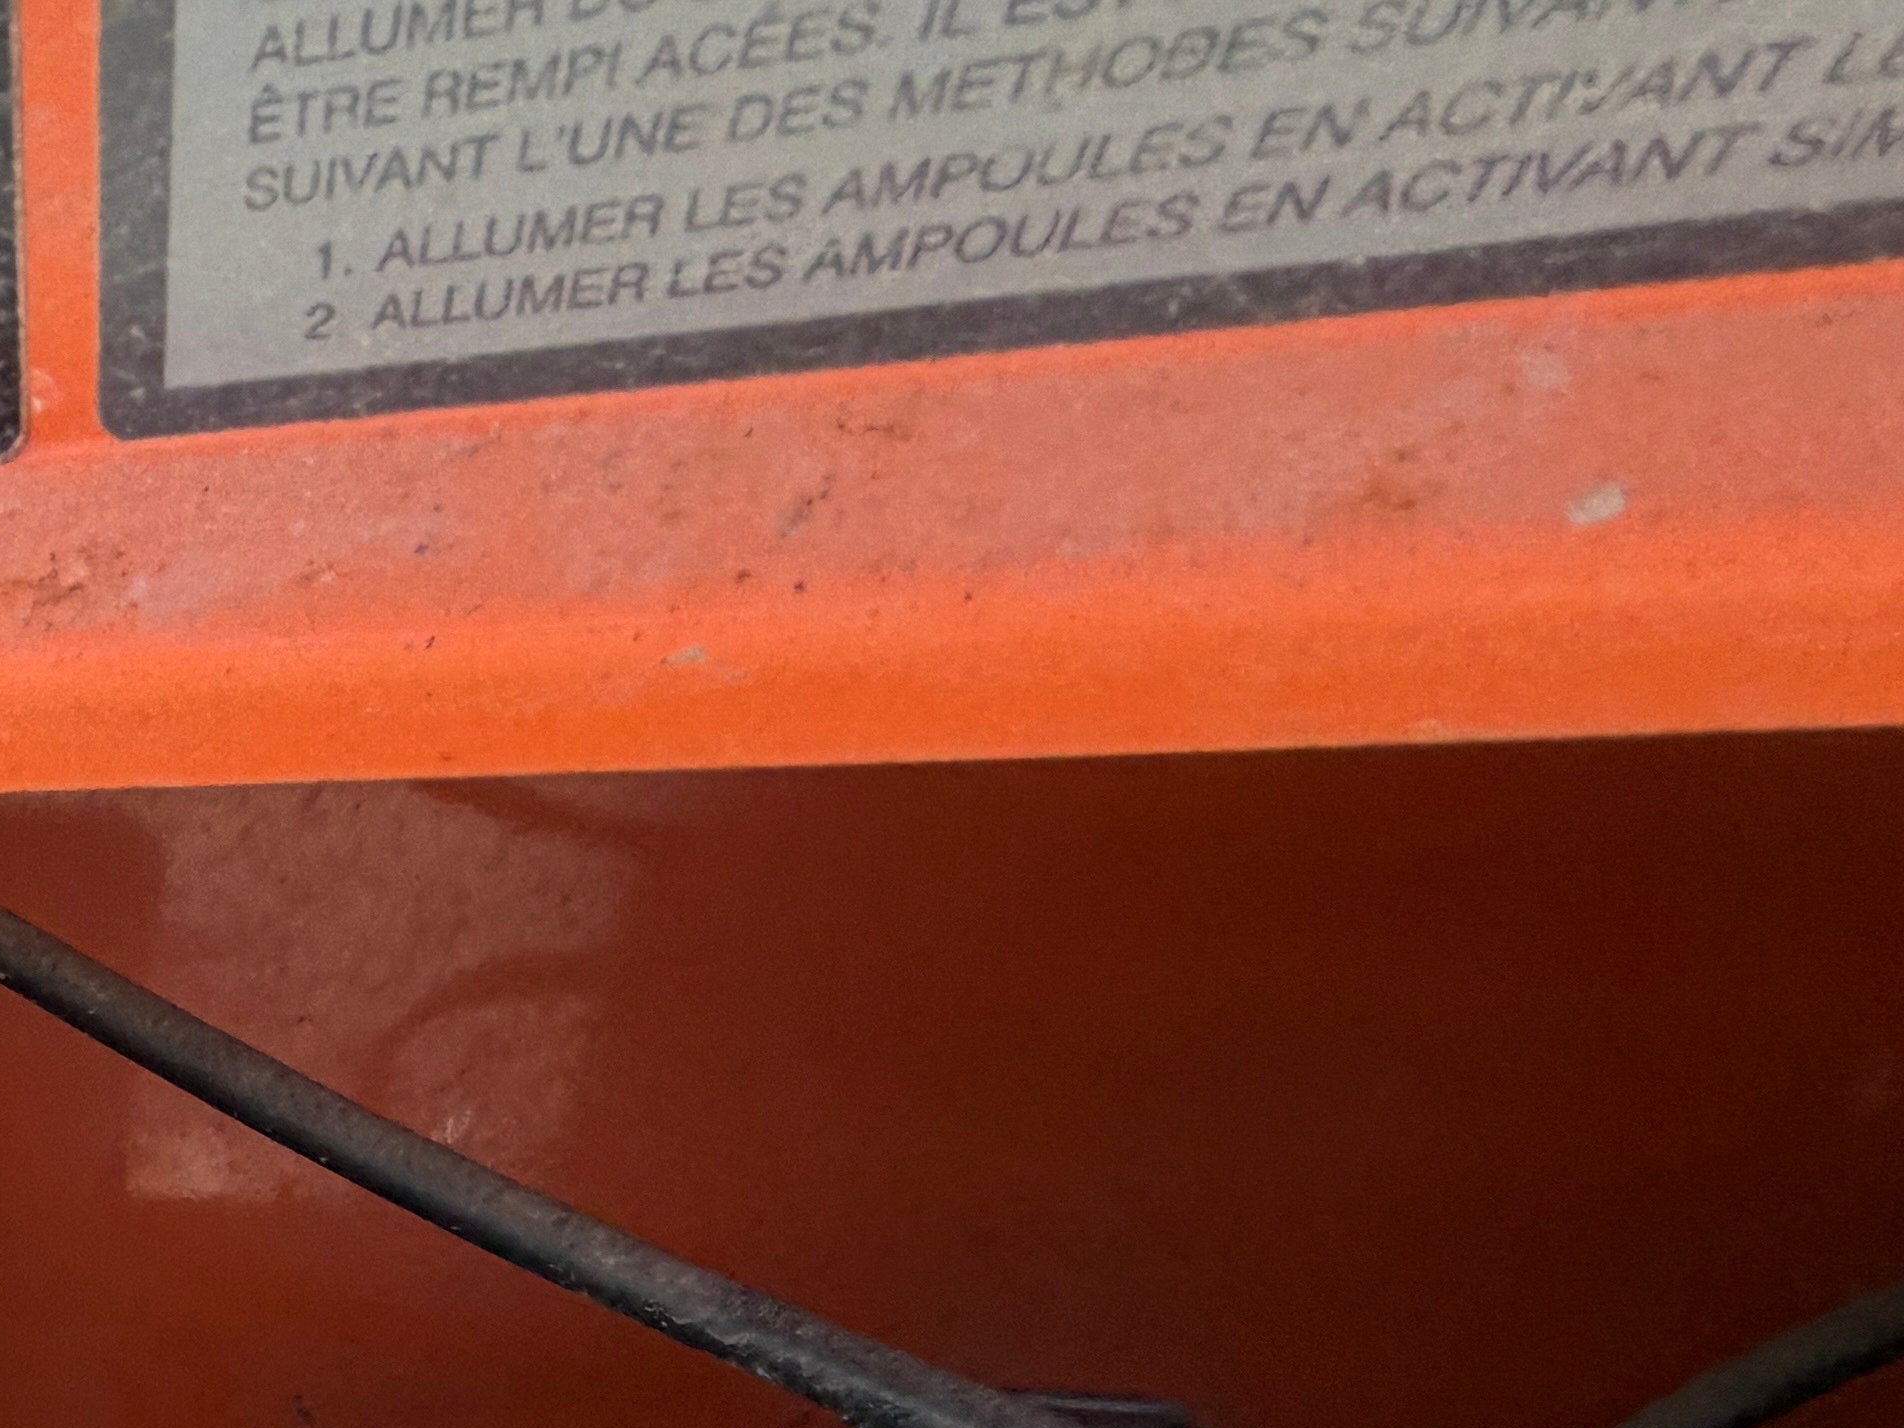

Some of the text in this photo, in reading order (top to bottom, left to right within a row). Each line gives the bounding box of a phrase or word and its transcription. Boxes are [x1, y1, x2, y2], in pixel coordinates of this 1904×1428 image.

[243, 133, 500, 213] SUIVANT
[517, 102, 712, 174] L'UNE
[726, 79, 868, 144] DES
[249, 80, 404, 145] ÊTRE
[317, 240, 352, 281] 1.
[376, 193, 666, 272] ALLUMER
[685, 172, 807, 232] LES
[822, 114, 1234, 215] AMPOULES
[1250, 98, 1372, 161] EN
[1378, 33, 1819, 142] ACTIVANT
[371, 262, 649, 330] ALLUMER
[667, 242, 787, 298] LES
[803, 193, 1200, 281] AMPOULES
[1220, 173, 1331, 233] EN
[1339, 122, 1761, 217] ACTIVANT
